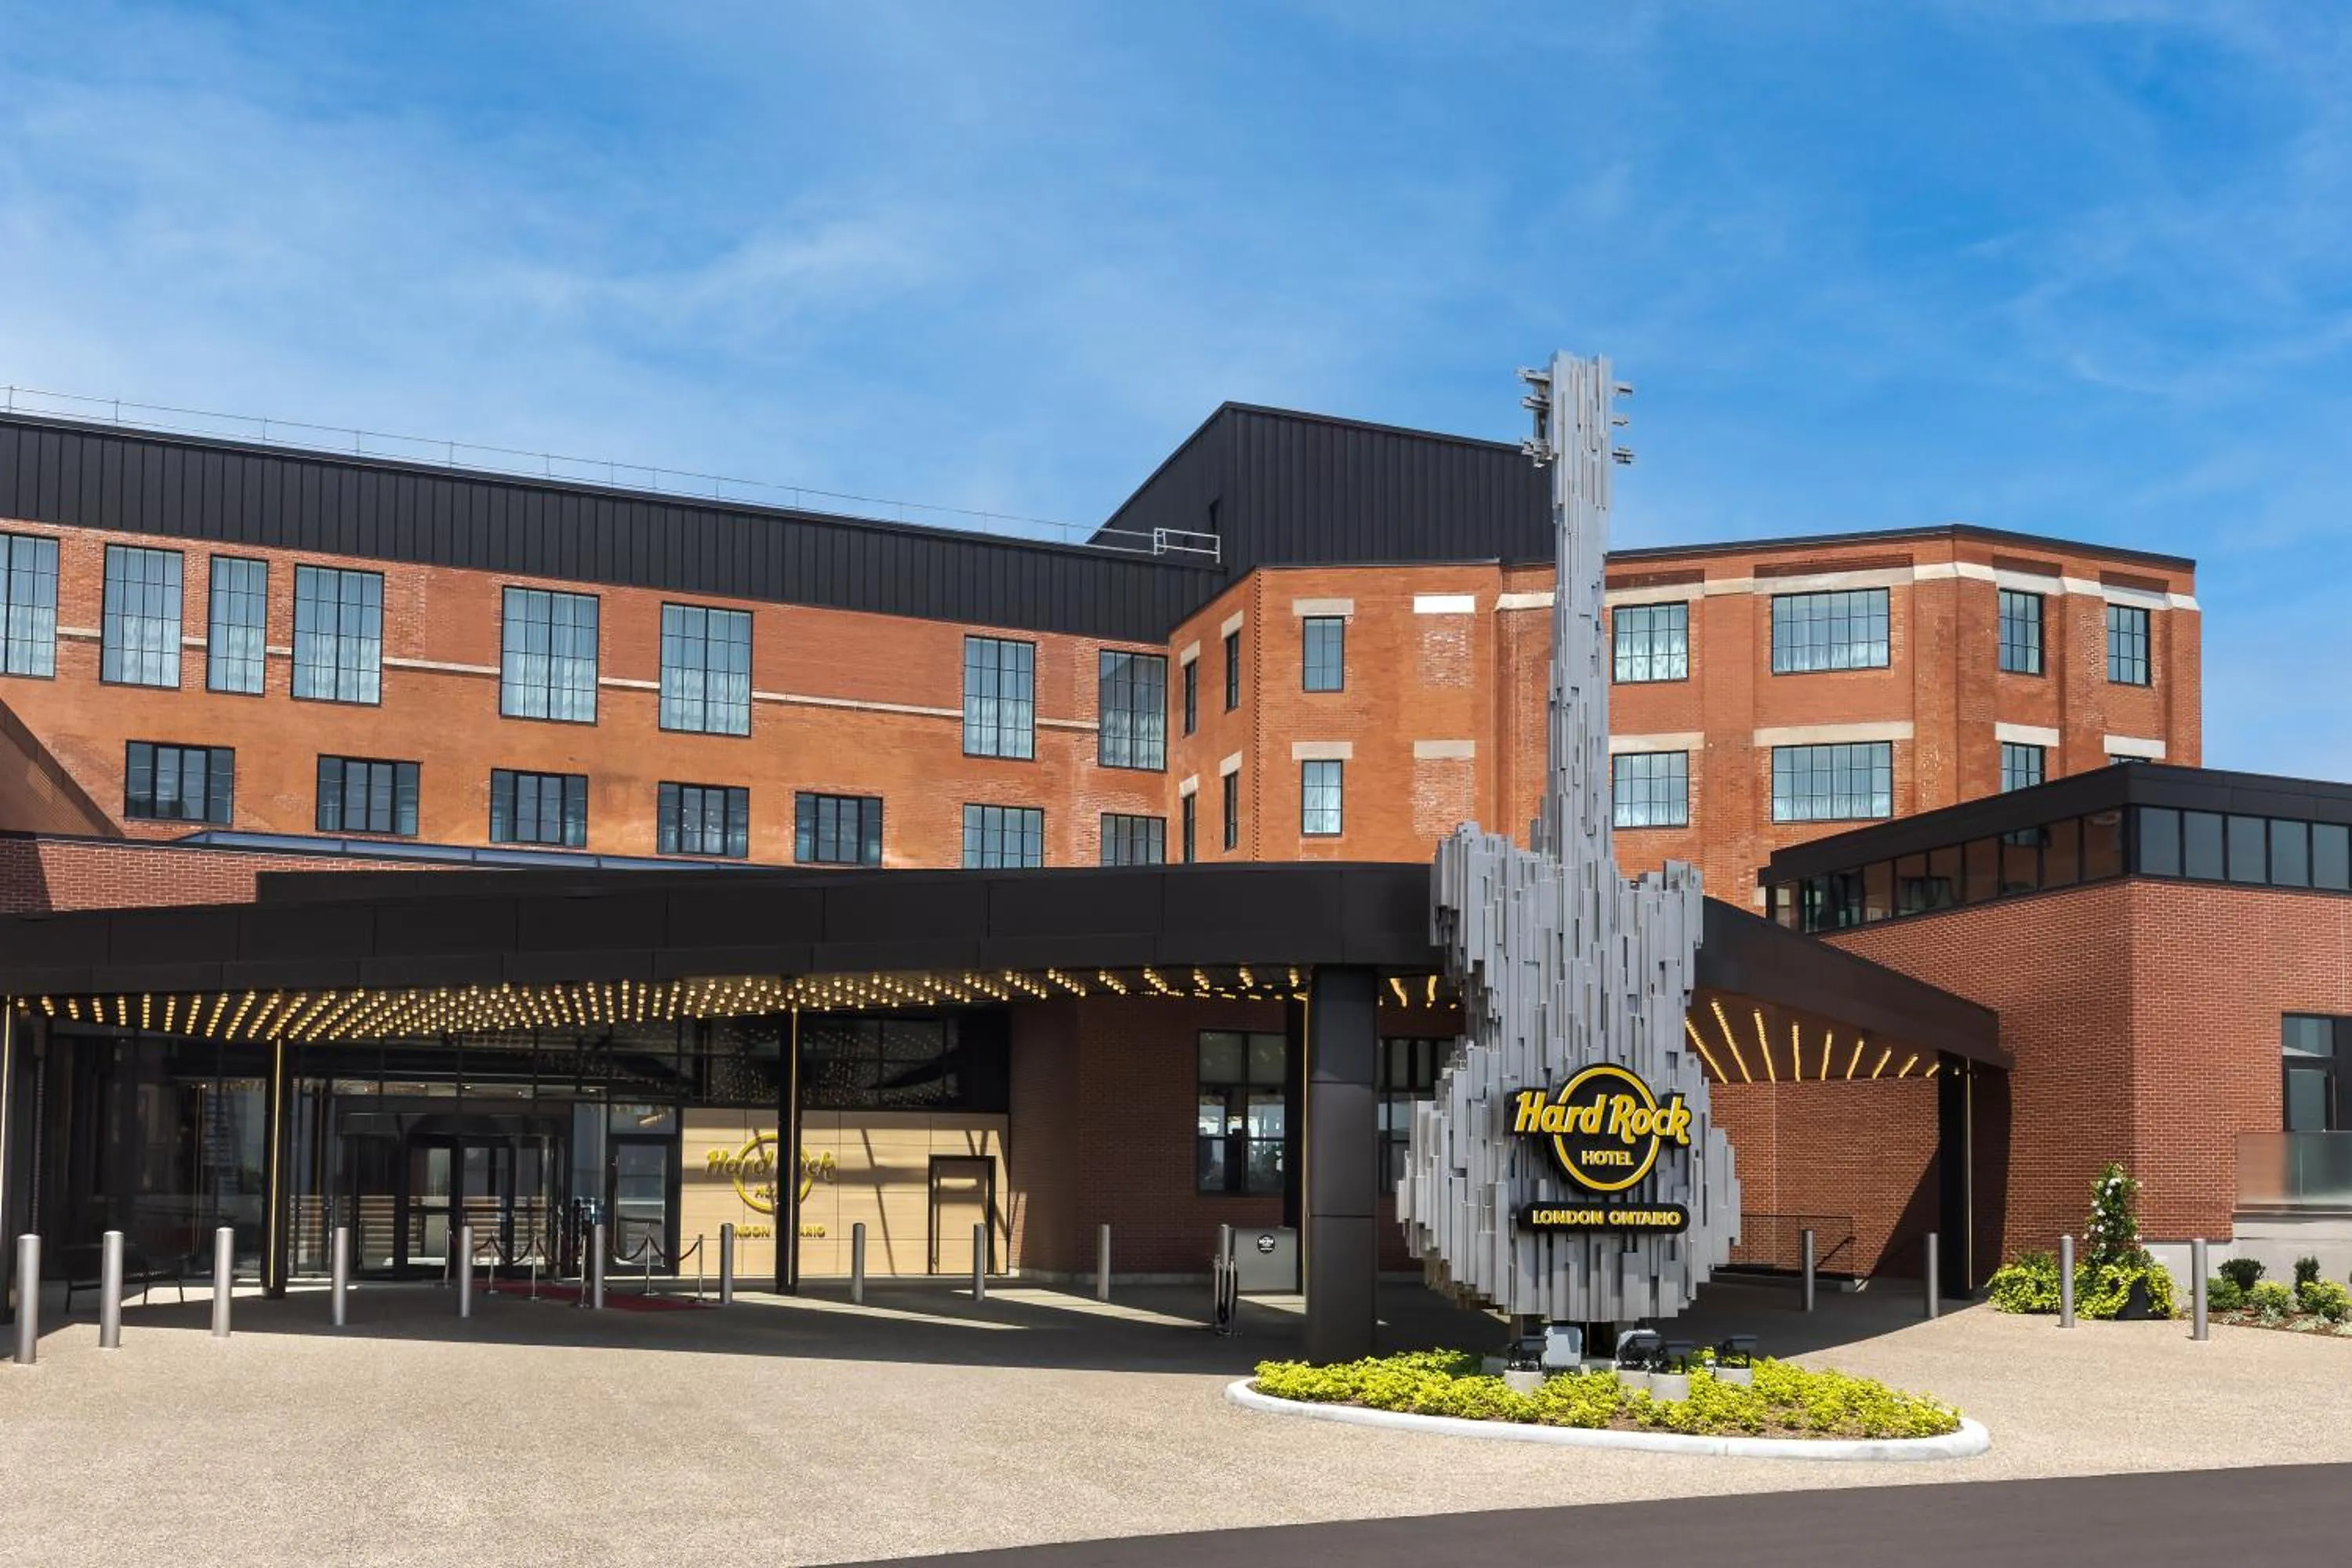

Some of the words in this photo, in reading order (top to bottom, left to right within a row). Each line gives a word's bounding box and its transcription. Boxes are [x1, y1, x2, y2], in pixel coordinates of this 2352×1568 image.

[1515, 1091, 1606, 1133] Hard
[1608, 1094, 1691, 1144] Rock
[707, 1149, 774, 1174] Hard
[1581, 1150, 1634, 1165] HOTEL
[1532, 1209, 1604, 1225] LONDON
[1608, 1210, 1682, 1226] ONTARIO
[735, 1225, 771, 1239] NDON
[800, 1225, 826, 1239] ARIO
